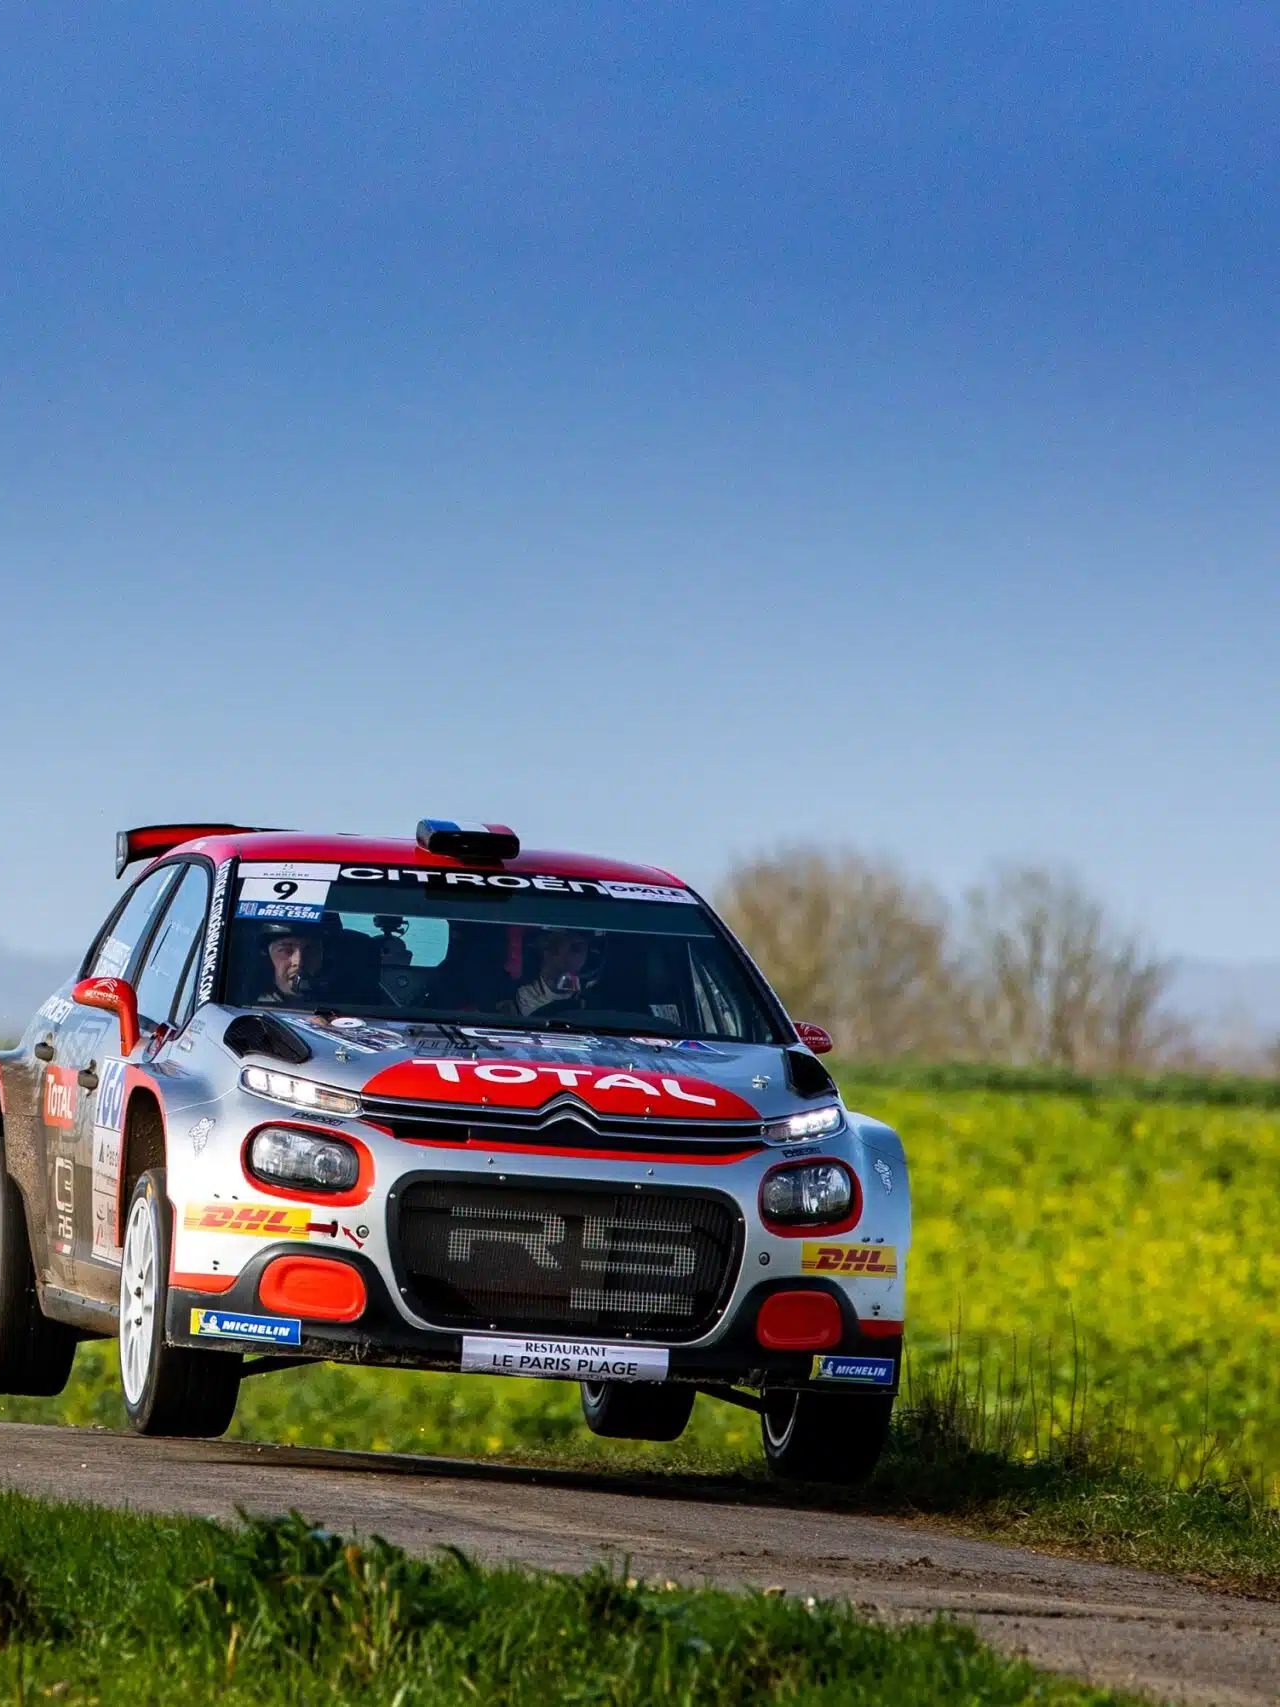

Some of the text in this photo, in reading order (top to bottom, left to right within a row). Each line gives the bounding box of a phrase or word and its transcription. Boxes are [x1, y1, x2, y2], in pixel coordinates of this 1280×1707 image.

[273, 881, 298, 900] 9
[340, 867, 609, 895] CITROËN
[610, 885, 685, 898] OPALE
[257, 908, 320, 919] BASE ESSAI
[412, 1059, 716, 1107] TOTAL
[47, 1073, 73, 1120] TOTAL
[199, 1205, 292, 1234] DHL
[448, 1205, 695, 1315] R5
[815, 1247, 886, 1273] DHL
[222, 1319, 291, 1337] MICHELIN
[525, 1342, 608, 1357] RESTAURANT
[492, 1354, 514, 1367] LE
[519, 1355, 571, 1372] PARIS
[577, 1358, 638, 1376] PLAGE
[835, 1365, 887, 1377] MICHELIN
